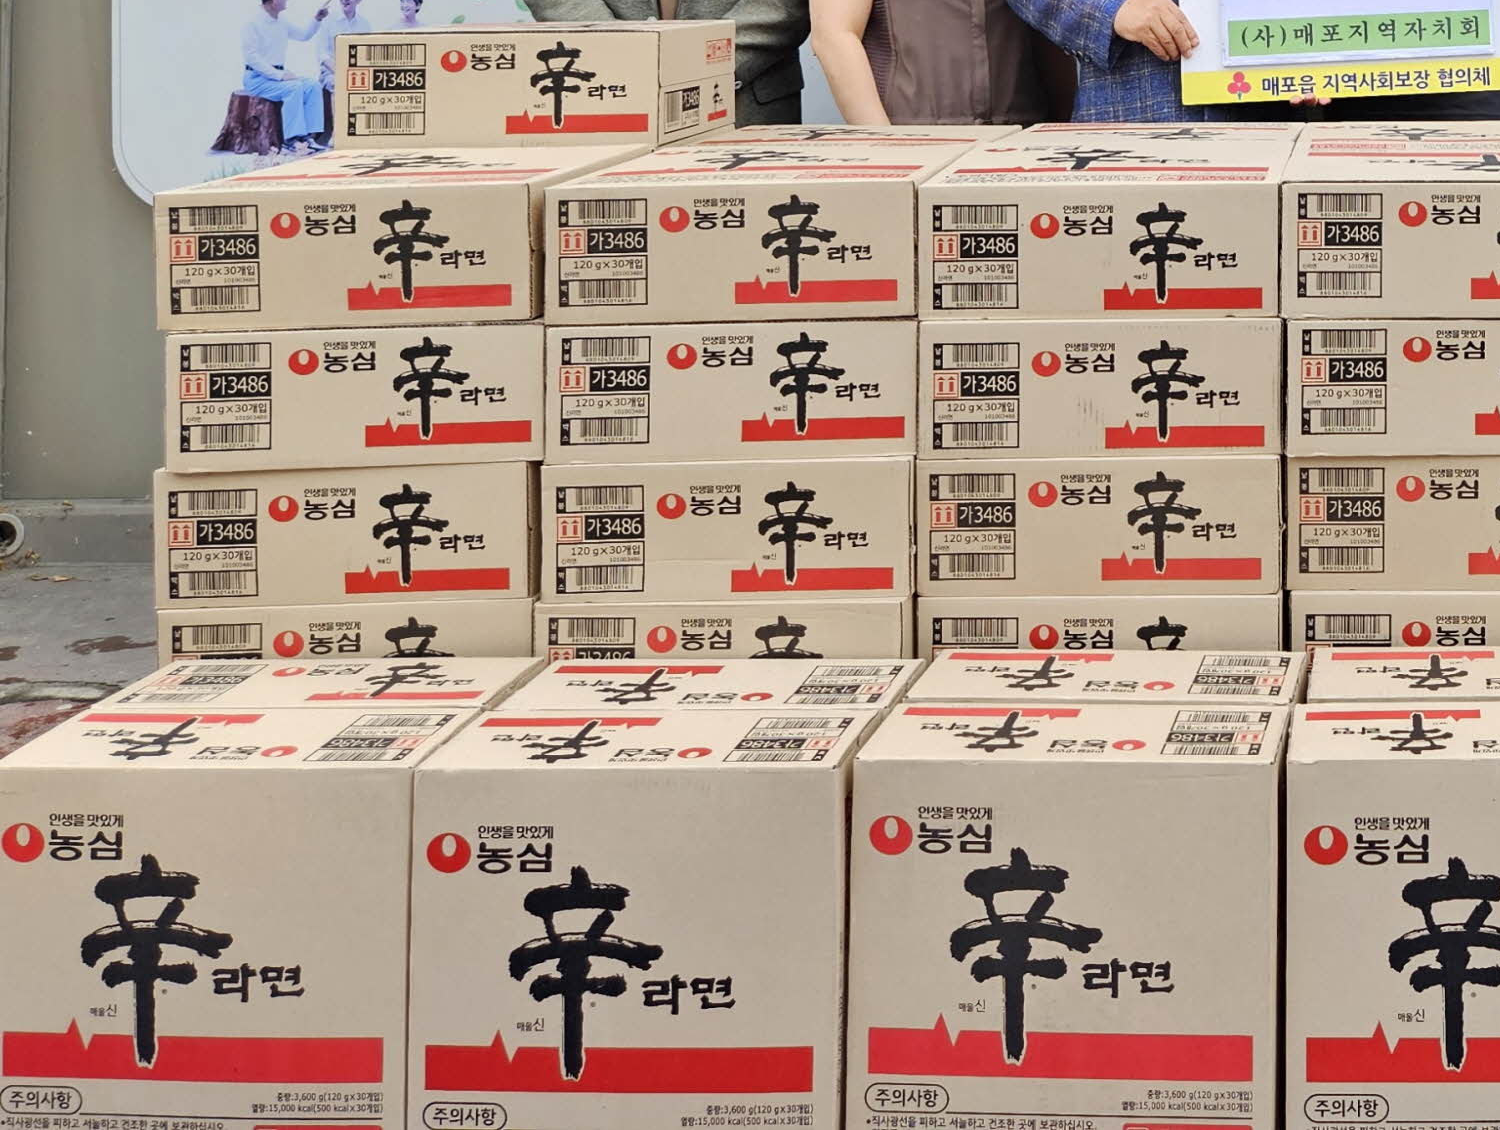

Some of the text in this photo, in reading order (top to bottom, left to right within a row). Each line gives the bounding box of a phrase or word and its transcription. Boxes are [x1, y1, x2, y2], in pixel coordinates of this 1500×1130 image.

[1241, 14, 1481, 50] (사)매포지역자치회
[470, 53, 516, 71] 농심
[374, 71, 424, 89] 가3486
[530, 41, 597, 128] 辛
[1261, 65, 1491, 96] 매포읍 지역사회보장 협의체
[361, 96, 378, 104] 120
[587, 83, 628, 100] 라면
[305, 215, 356, 236] 농심
[694, 209, 744, 229] 농심
[1431, 205, 1480, 225] 농심
[1064, 216, 1112, 236] 농심
[1326, 224, 1380, 244] 가3486
[200, 236, 257, 258] 가3486
[589, 230, 645, 252] 가3486
[961, 235, 1016, 256] 가3486
[393, 337, 469, 437] 辛
[835, 383, 880, 401] 라면
[1132, 340, 1205, 439] 辛
[1429, 480, 1478, 500] 농심
[690, 496, 741, 516] 농심
[958, 504, 1013, 525] 가3486
[198, 521, 255, 543] 가3486
[309, 633, 360, 655] 농심
[478, 826, 553, 840] 인생을 맛있게
[918, 822, 992, 854] 농심
[49, 830, 122, 861] 농심
[1354, 834, 1429, 865] 농심
[477, 842, 552, 874] 농심
[81, 854, 233, 1064] 辛
[950, 847, 1103, 1061] 辛
[212, 963, 304, 1002] 라면
[509, 866, 663, 1079] 辛
[1082, 958, 1174, 998] 라면
[642, 975, 735, 1015] 라면
[9, 1090, 72, 1110] 주의사항
[875, 1089, 938, 1108] 주의사항
[1314, 1098, 1379, 1118] 주의사항
[433, 1106, 498, 1127] 주의사항
